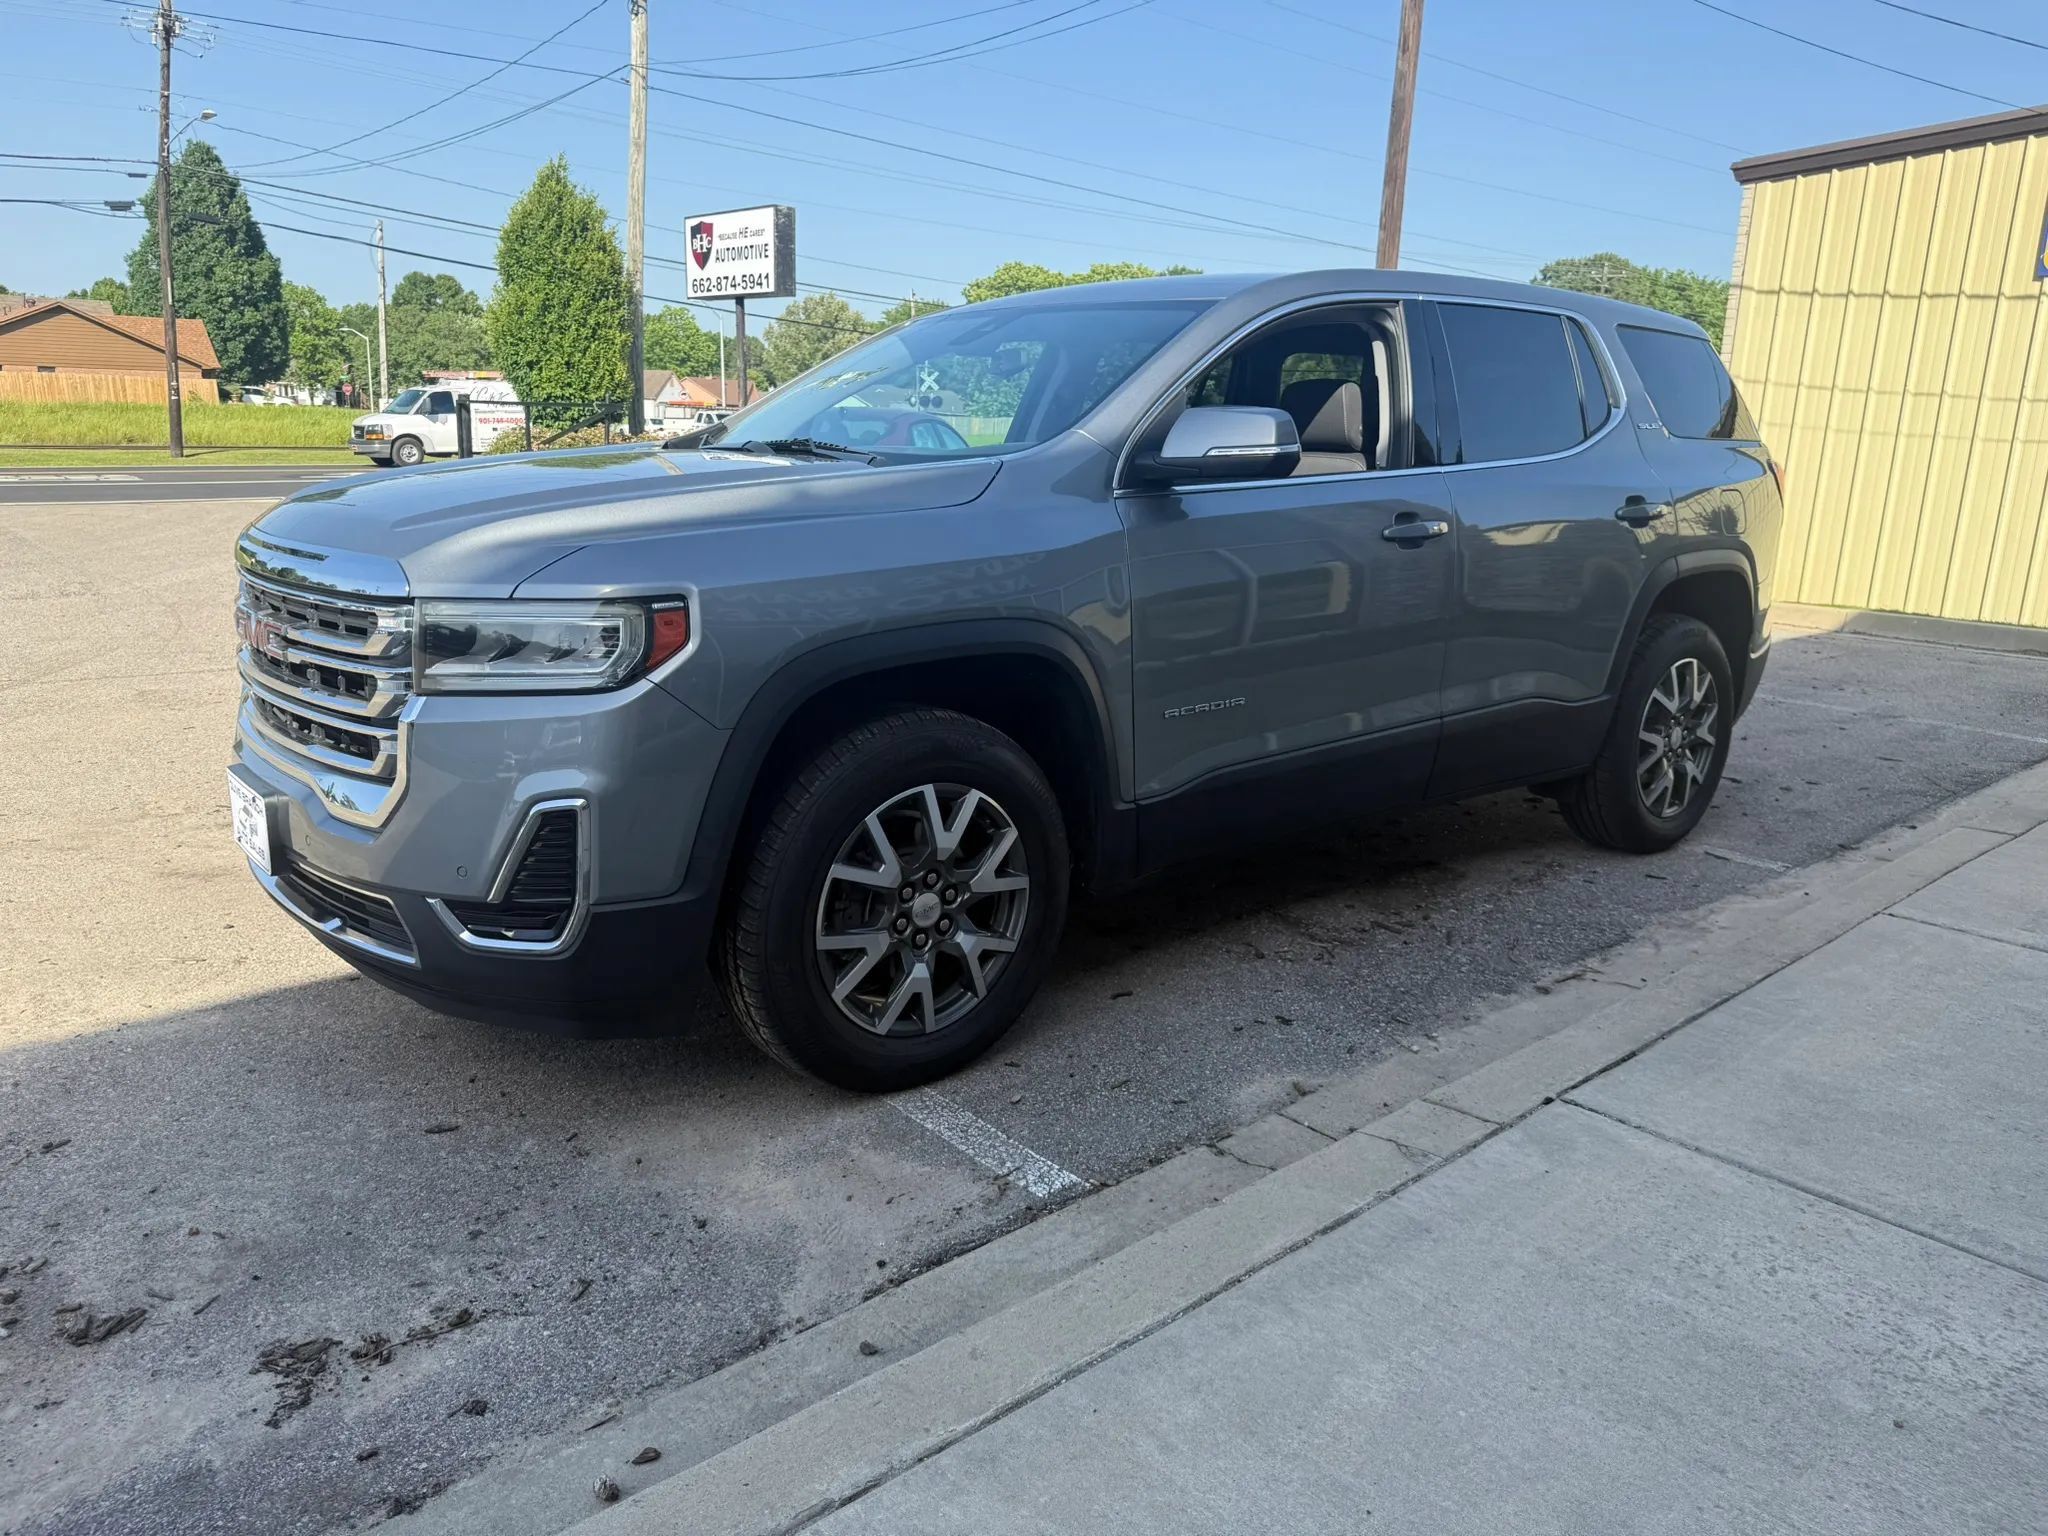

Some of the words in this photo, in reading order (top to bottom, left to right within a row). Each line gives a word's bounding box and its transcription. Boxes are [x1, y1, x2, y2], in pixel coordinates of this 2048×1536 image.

[738, 226, 749, 239] HE
[715, 243, 769, 263] AUTOMOTIVE
[692, 273, 769, 293] 662-874-5941
[1164, 697, 1246, 719] ACADIA
